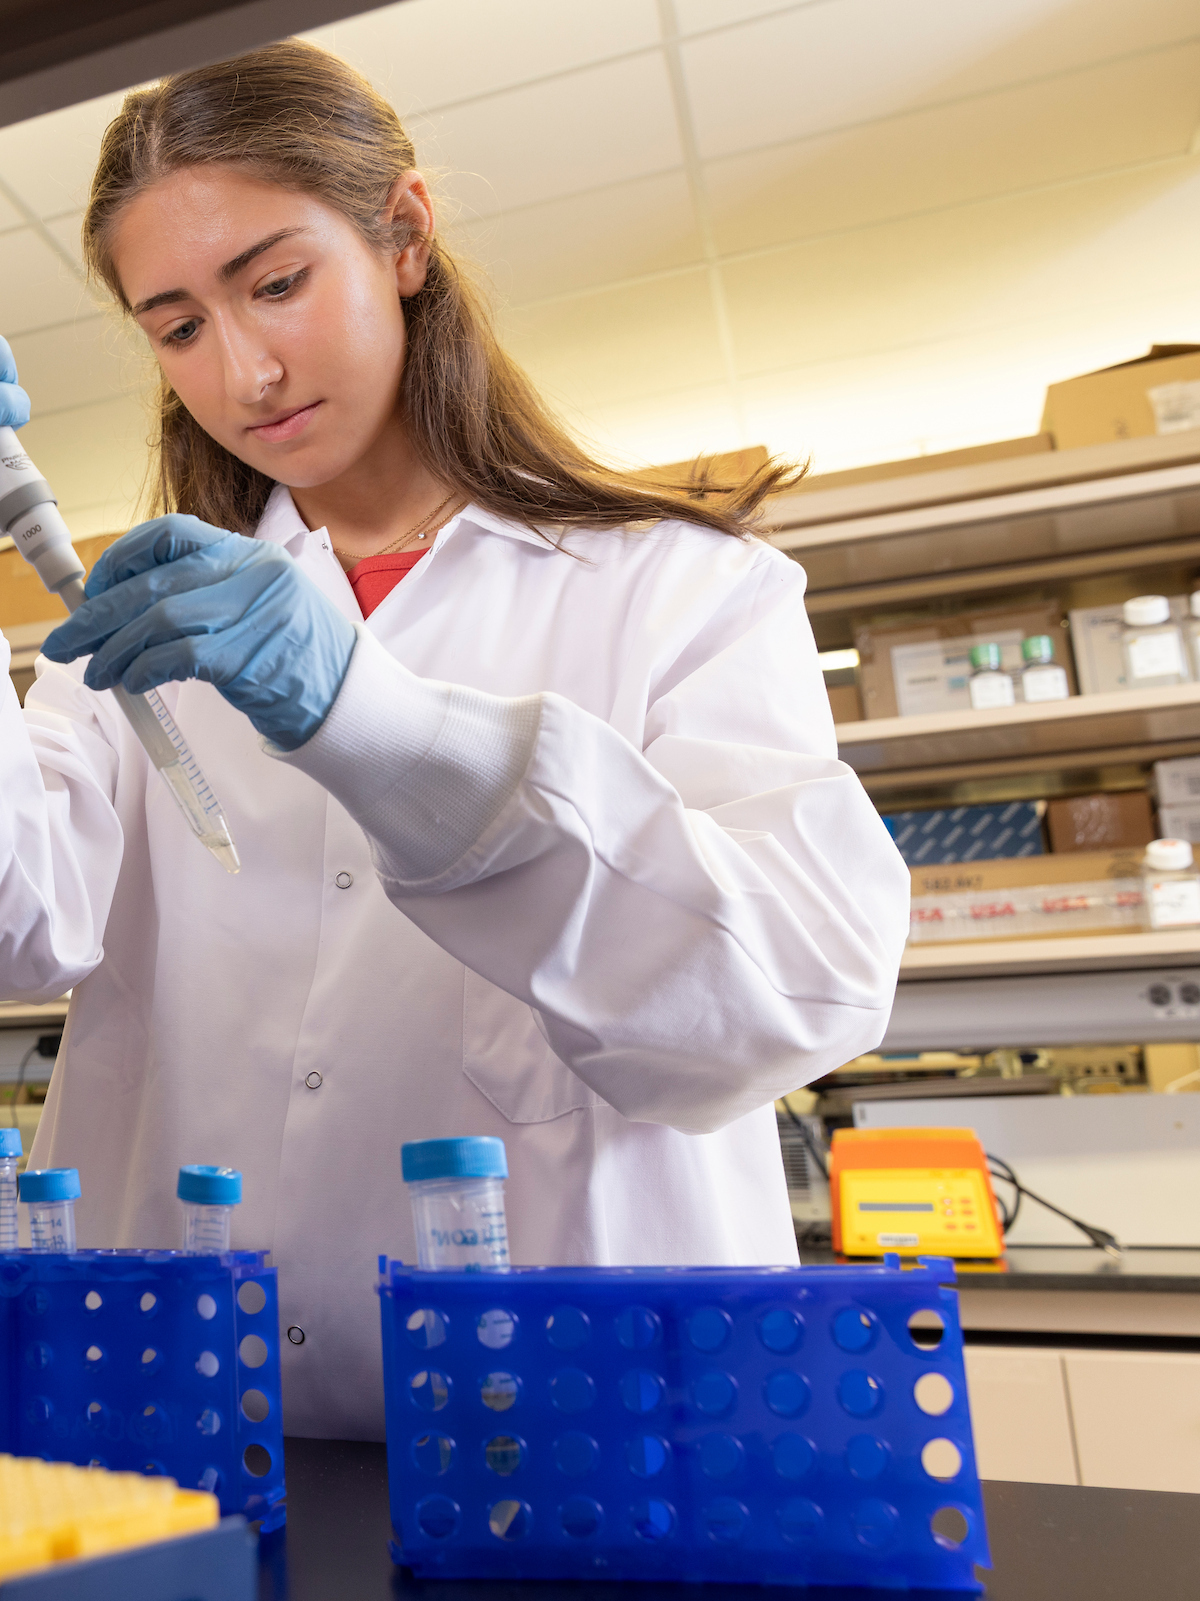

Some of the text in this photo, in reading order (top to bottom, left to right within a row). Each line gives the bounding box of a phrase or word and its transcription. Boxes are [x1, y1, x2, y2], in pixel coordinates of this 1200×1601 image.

[22, 524, 42, 541] 1000
[970, 902, 1015, 918] USA
[51, 1218, 62, 1228] 14
